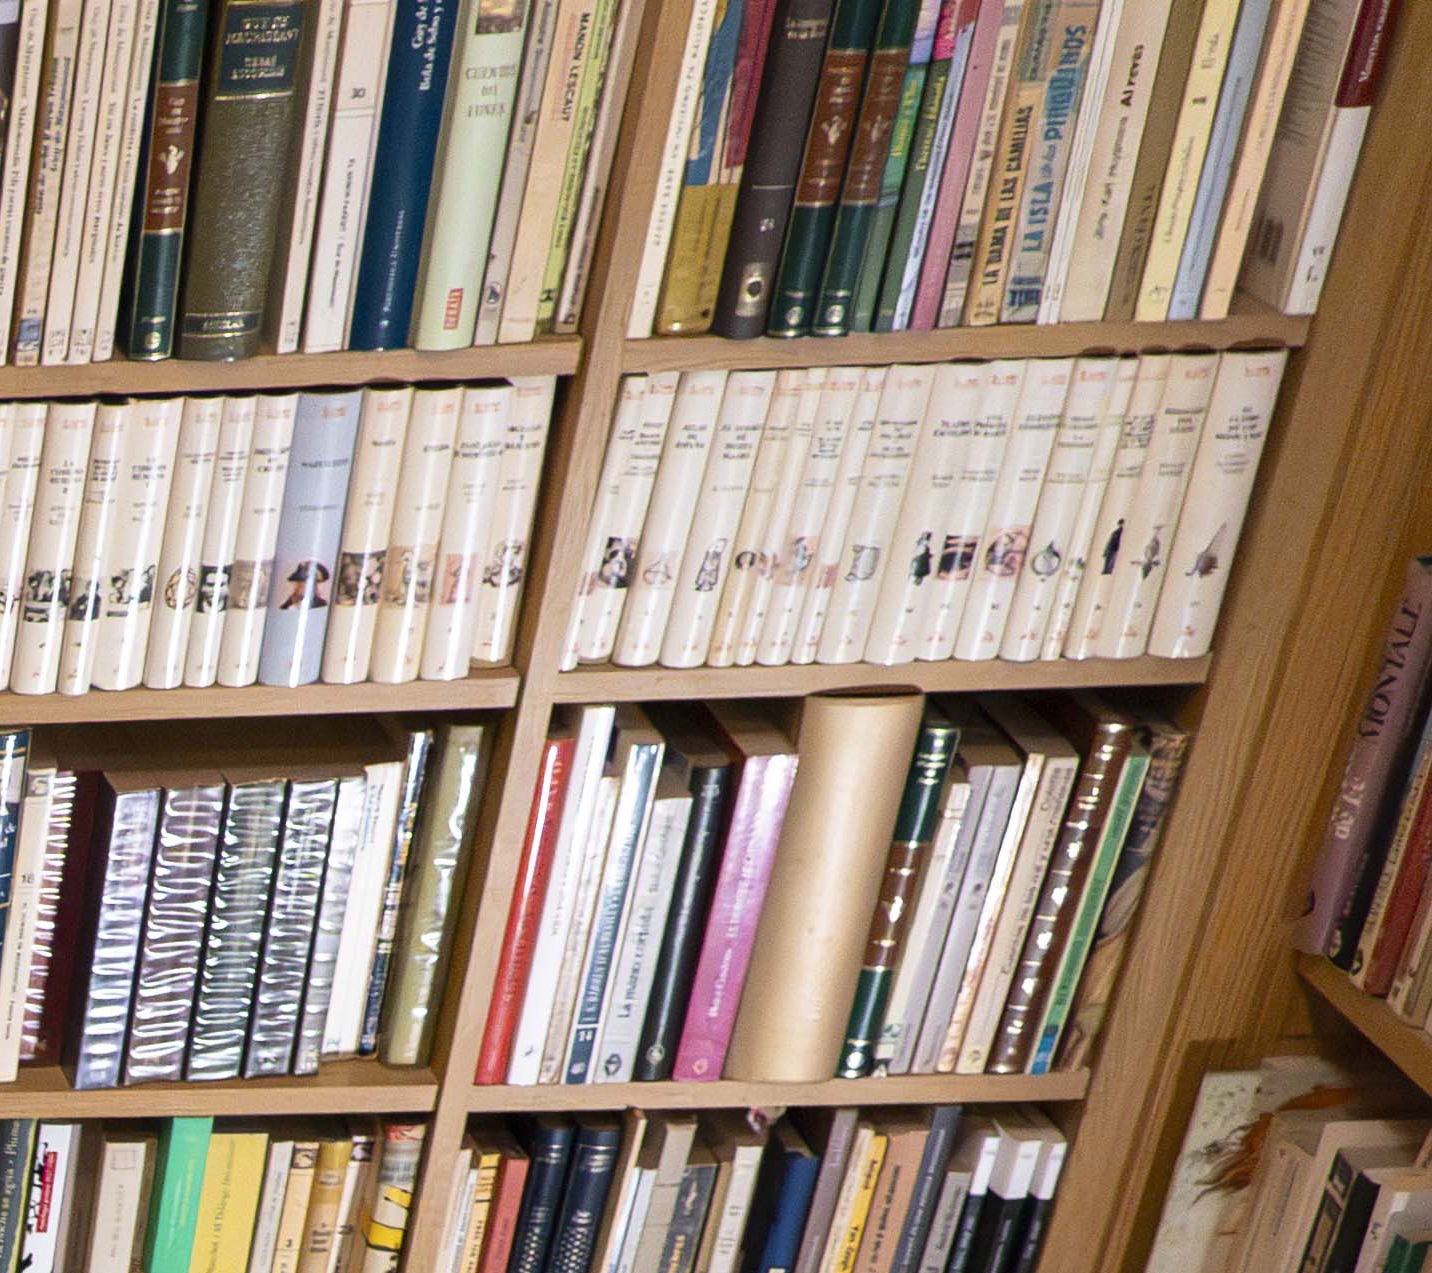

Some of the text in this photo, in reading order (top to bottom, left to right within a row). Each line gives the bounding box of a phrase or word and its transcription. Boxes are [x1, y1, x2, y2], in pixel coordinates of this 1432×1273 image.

[561, 12, 590, 122] MANON LESCAUT
[1000, 176, 1017, 201] LAS
[1027, 181, 1054, 224] ISLA
[985, 226, 1009, 265] DAMA
[1020, 230, 1043, 252] LA
[982, 268, 1001, 287] LA
[622, 962, 642, 1001] mano
[617, 1003, 632, 1018] La
